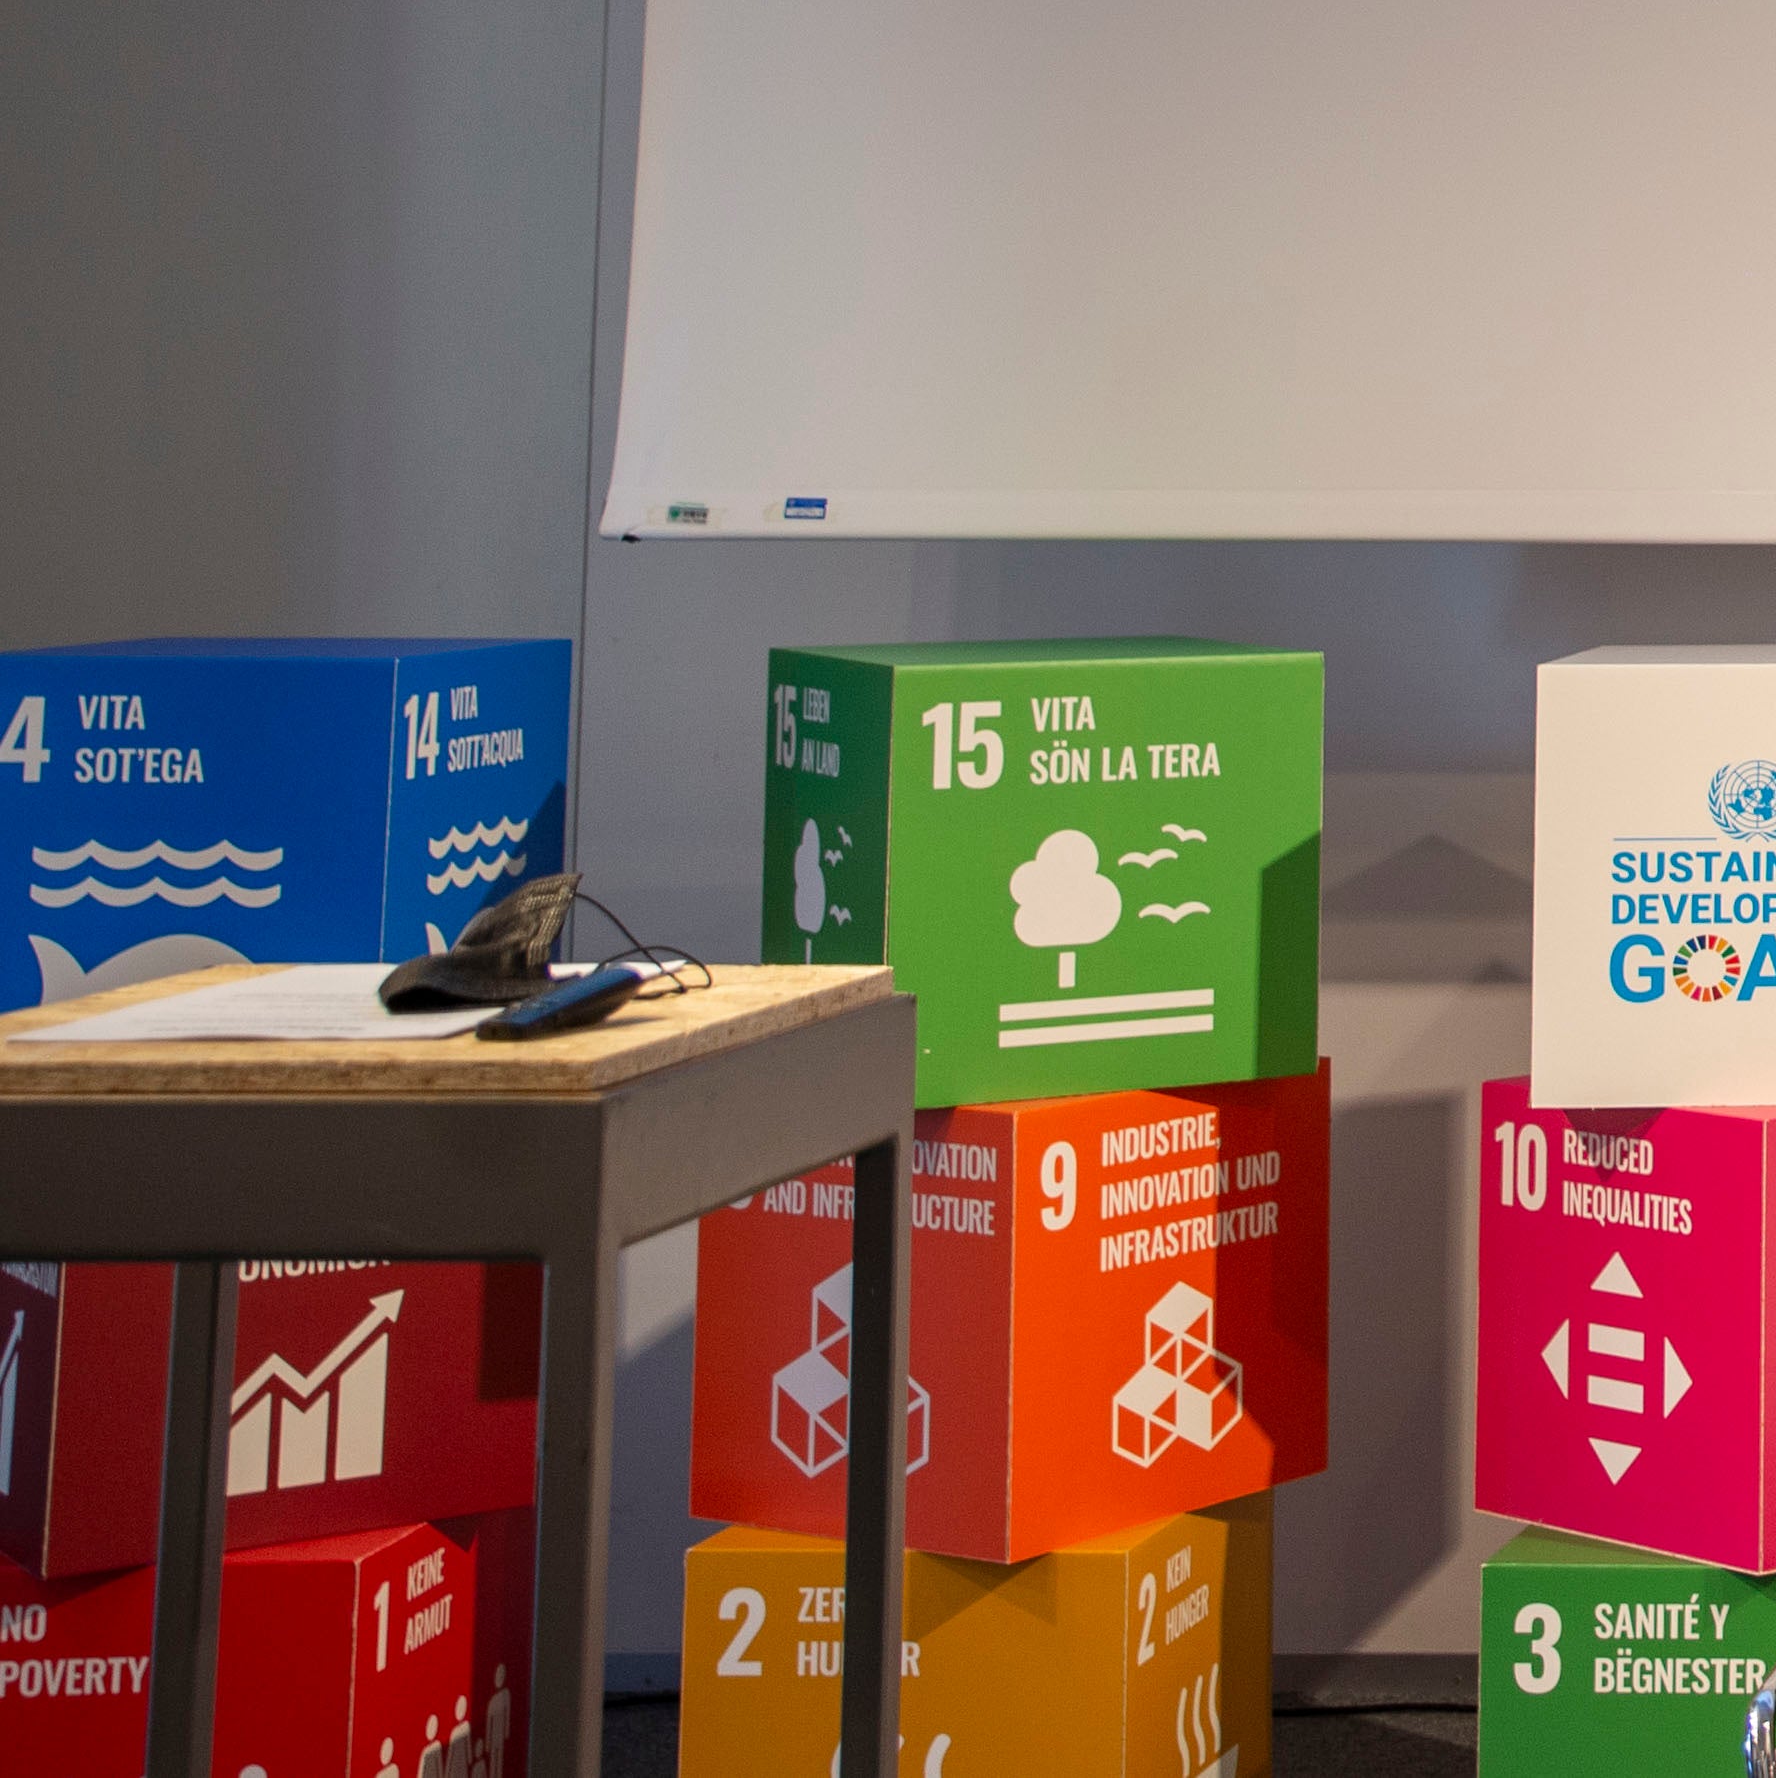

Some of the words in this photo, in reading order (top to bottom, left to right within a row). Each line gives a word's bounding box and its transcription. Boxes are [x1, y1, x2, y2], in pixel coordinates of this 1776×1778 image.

[78, 695, 146, 730] VITA
[450, 685, 478, 721] VITA
[774, 684, 797, 768] 15
[803, 687, 831, 724] LEBEN
[1030, 697, 1096, 732] VITA
[0, 696, 50, 784] 4
[404, 691, 440, 779] 14
[447, 727, 524, 773] SOTT'ACQUA
[801, 738, 815, 772] AN
[816, 741, 840, 777] LAND
[921, 701, 1003, 789] 15
[74, 748, 204, 783] SOT'EGA
[1029, 740, 1091, 785] SÖN
[1101, 746, 1138, 782] LA
[1147, 743, 1221, 778] TERA
[912, 1140, 998, 1183] OVATION
[1102, 1111, 1221, 1167] INDUSTRIE,
[1563, 1129, 1654, 1176] REDUCED
[1041, 1142, 1078, 1230] 9
[1101, 1161, 1229, 1220] INNOVATION
[1236, 1150, 1280, 1191] UND
[1495, 1122, 1547, 1211] 10
[763, 1181, 807, 1214] AND
[1562, 1180, 1693, 1235] INEQUALITIES
[1101, 1201, 1279, 1272] INFRASTRUKTUR
[406, 1547, 446, 1601] KEINE
[1166, 1545, 1191, 1593] KEIN
[0, 1603, 47, 1643] NO
[374, 1581, 390, 1672] 1
[404, 1593, 453, 1655] ARMUT
[797, 1587, 846, 1622] ZER
[1137, 1572, 1156, 1666] 2
[1166, 1584, 1208, 1645] HUNGER
[1594, 1593, 1699, 1640] SANITÉ
[1709, 1604, 1730, 1639] Y
[716, 1587, 766, 1677] 2
[1513, 1603, 1562, 1694] 3
[0, 1655, 149, 1700] POVERTY
[1594, 1647, 1768, 1694] BËGNESTER
